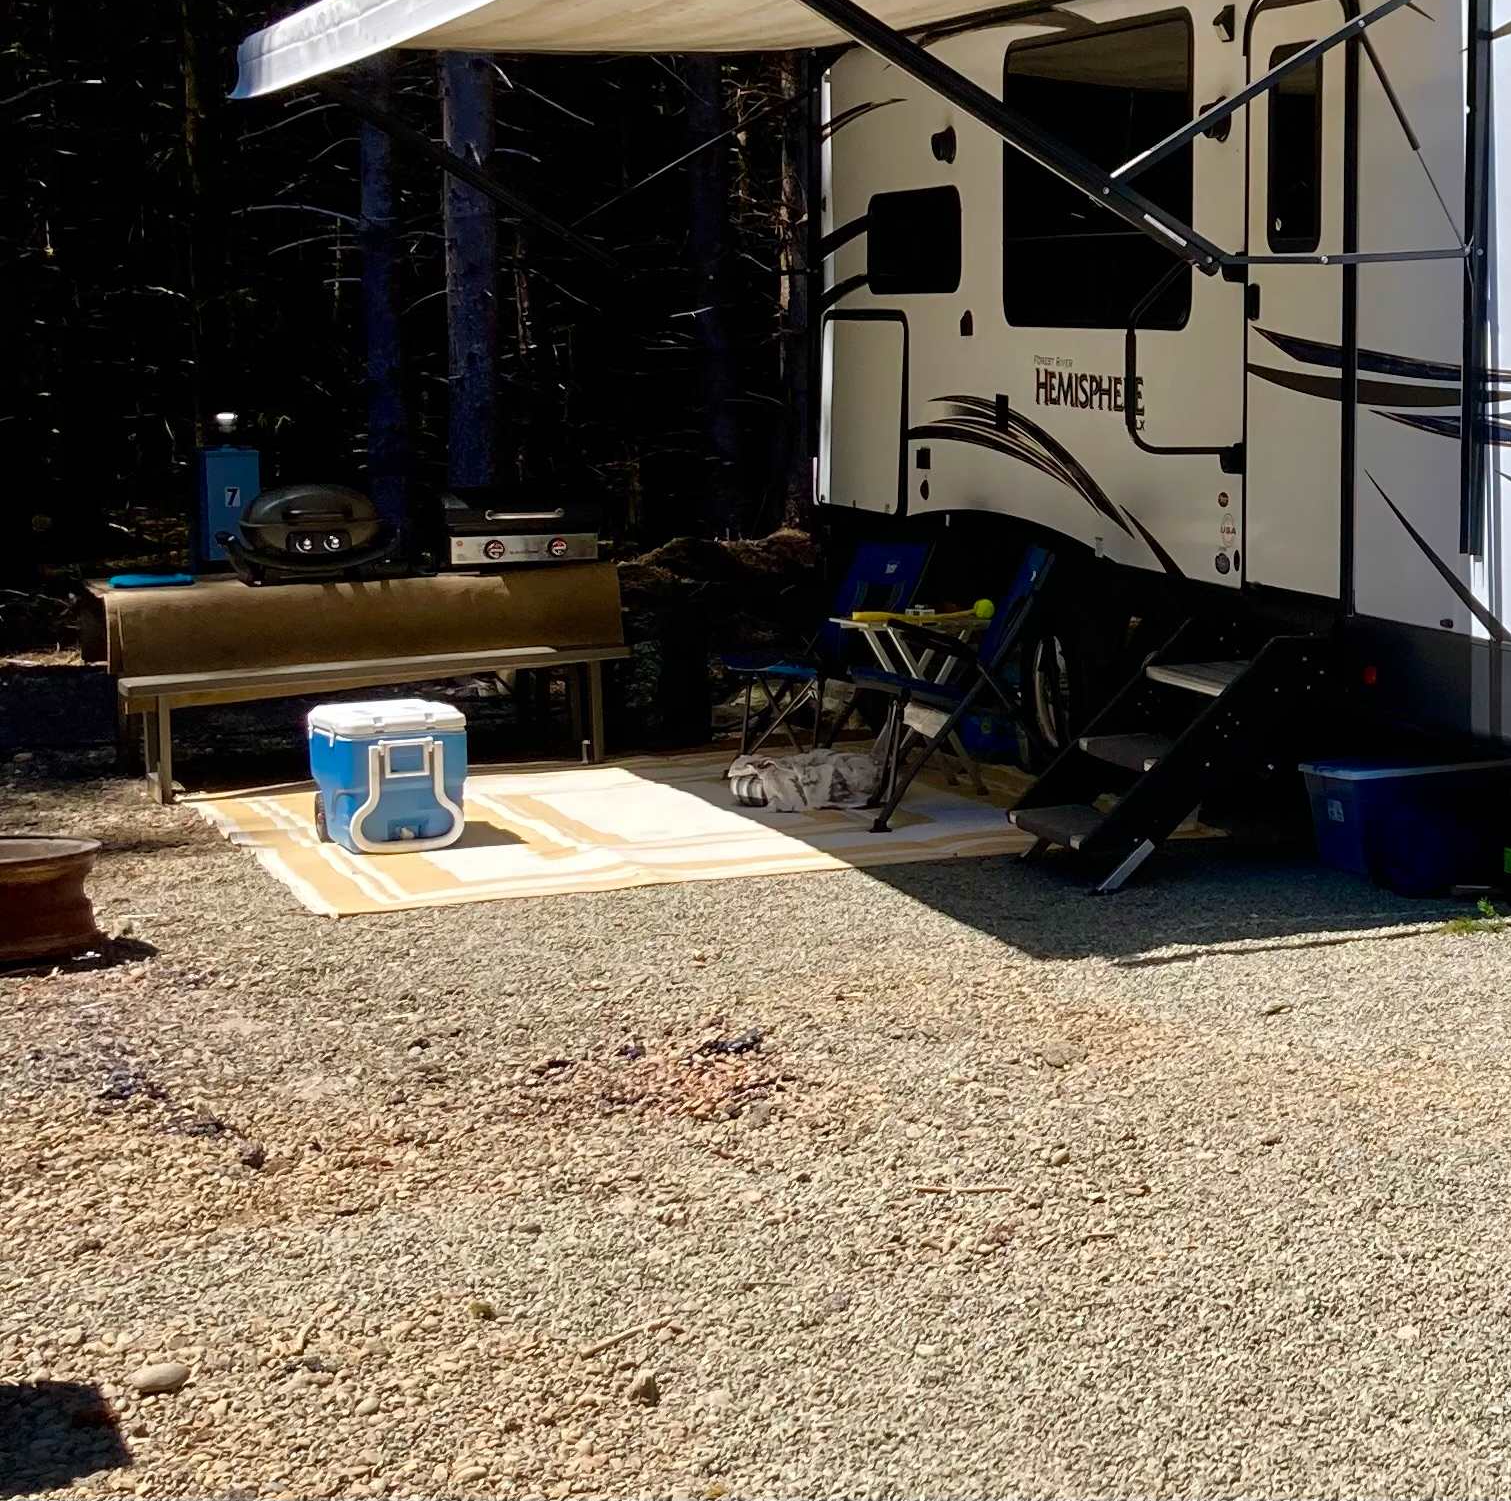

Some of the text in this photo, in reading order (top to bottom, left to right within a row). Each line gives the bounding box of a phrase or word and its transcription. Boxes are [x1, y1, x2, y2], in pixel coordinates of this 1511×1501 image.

[1035, 367, 1145, 416] HEMISPHEE
[226, 488, 239, 506] 7
[1220, 526, 1236, 535] USA
